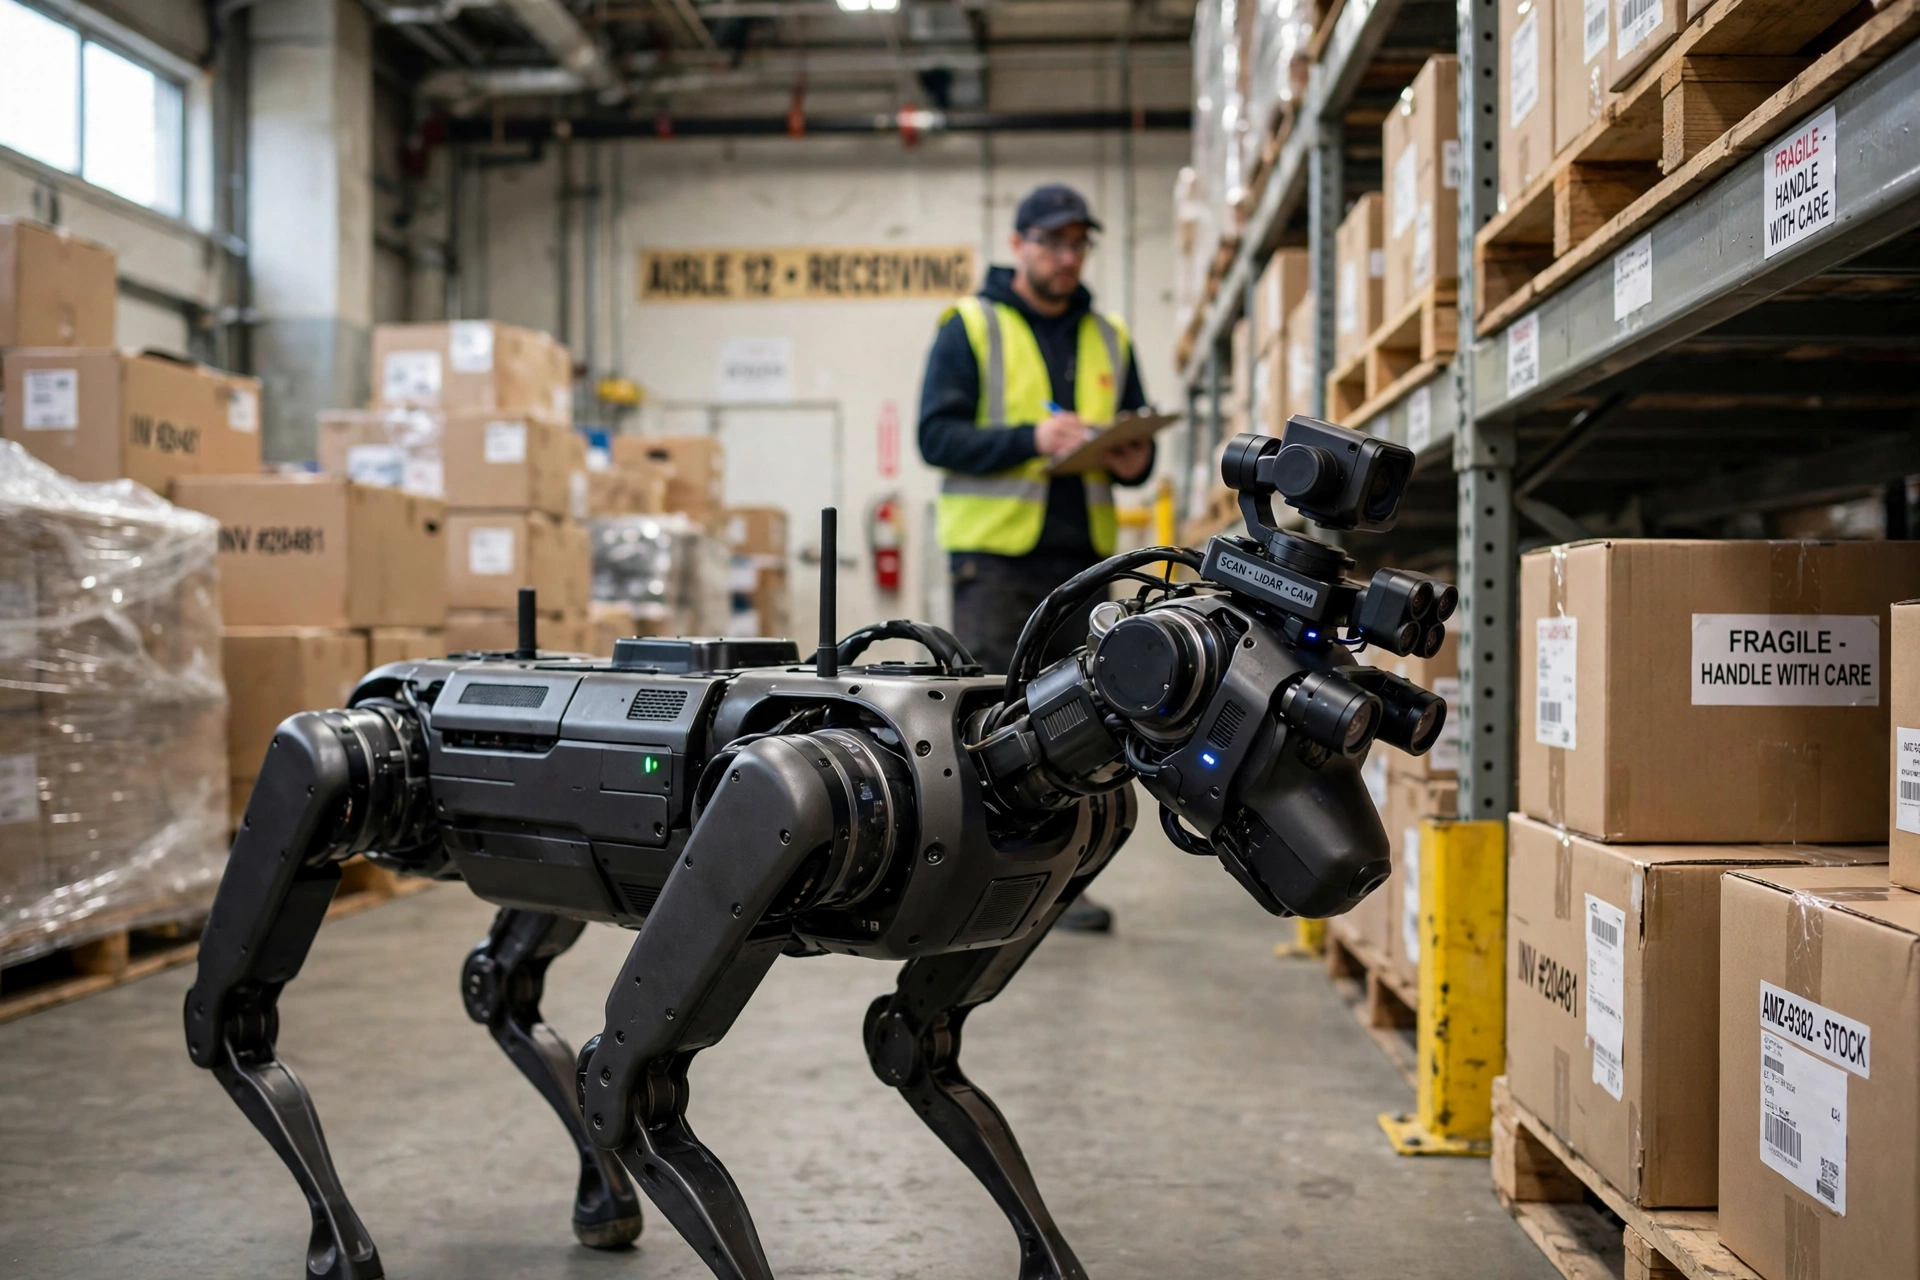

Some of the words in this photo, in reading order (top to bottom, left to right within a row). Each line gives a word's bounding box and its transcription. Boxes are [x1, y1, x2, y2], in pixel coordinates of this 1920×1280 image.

[1775, 127, 1819, 178] FRAGILE
[1775, 161, 1818, 211] HANDLE
[1770, 208, 1795, 246] WITH
[1798, 190, 1829, 230] CARE
[650, 253, 730, 296] AISLE
[743, 255, 774, 294] 12
[806, 253, 972, 295] RECEIVING
[1220, 556, 1247, 576] SCAN
[1254, 570, 1283, 591] LIDAR
[1290, 587, 1314, 605] CAM
[1730, 630, 1832, 653] FRAGILE
[1701, 663, 1772, 685] HANDLE
[1777, 663, 1819, 686] WITH
[1824, 663, 1872, 686] CARE
[1518, 938, 1536, 988] INV
[1538, 953, 1578, 1019] #20481
[1762, 991, 1814, 1042] AMZ-9382
[1824, 1018, 1867, 1068] STOCK
